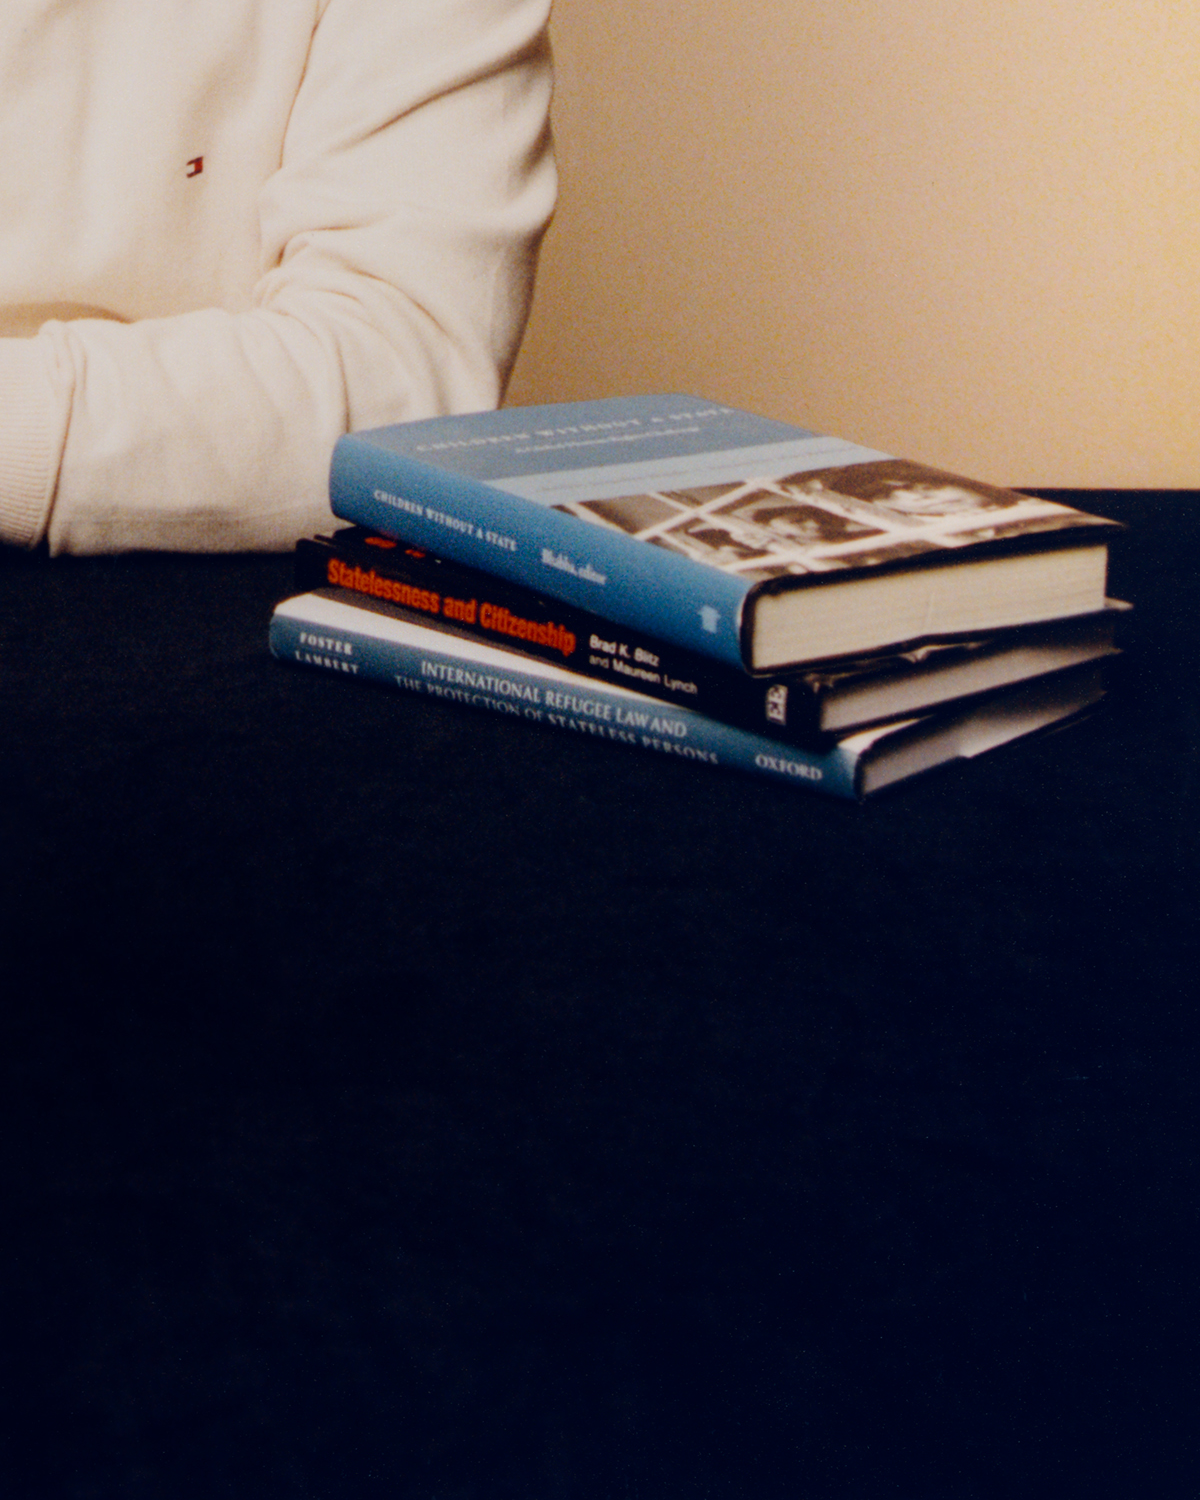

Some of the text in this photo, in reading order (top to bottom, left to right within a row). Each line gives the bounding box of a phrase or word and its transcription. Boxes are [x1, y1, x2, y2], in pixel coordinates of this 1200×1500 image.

[373, 489, 518, 552] CHILDREN WITHOUT A STATE
[326, 557, 577, 658] Statelessness and Citizenship
[294, 650, 360, 675] LAMBERT
[299, 631, 354, 657] FOSTER
[588, 633, 660, 668] Brad K. Blitz
[588, 654, 699, 695] and Maureen Lynch
[393, 674, 719, 765] THE PROTECTION OF STATELESS PERSONS
[420, 660, 688, 738] INTERNATIONAL REFUGEE LAW AND
[754, 753, 824, 782] OXFORD
